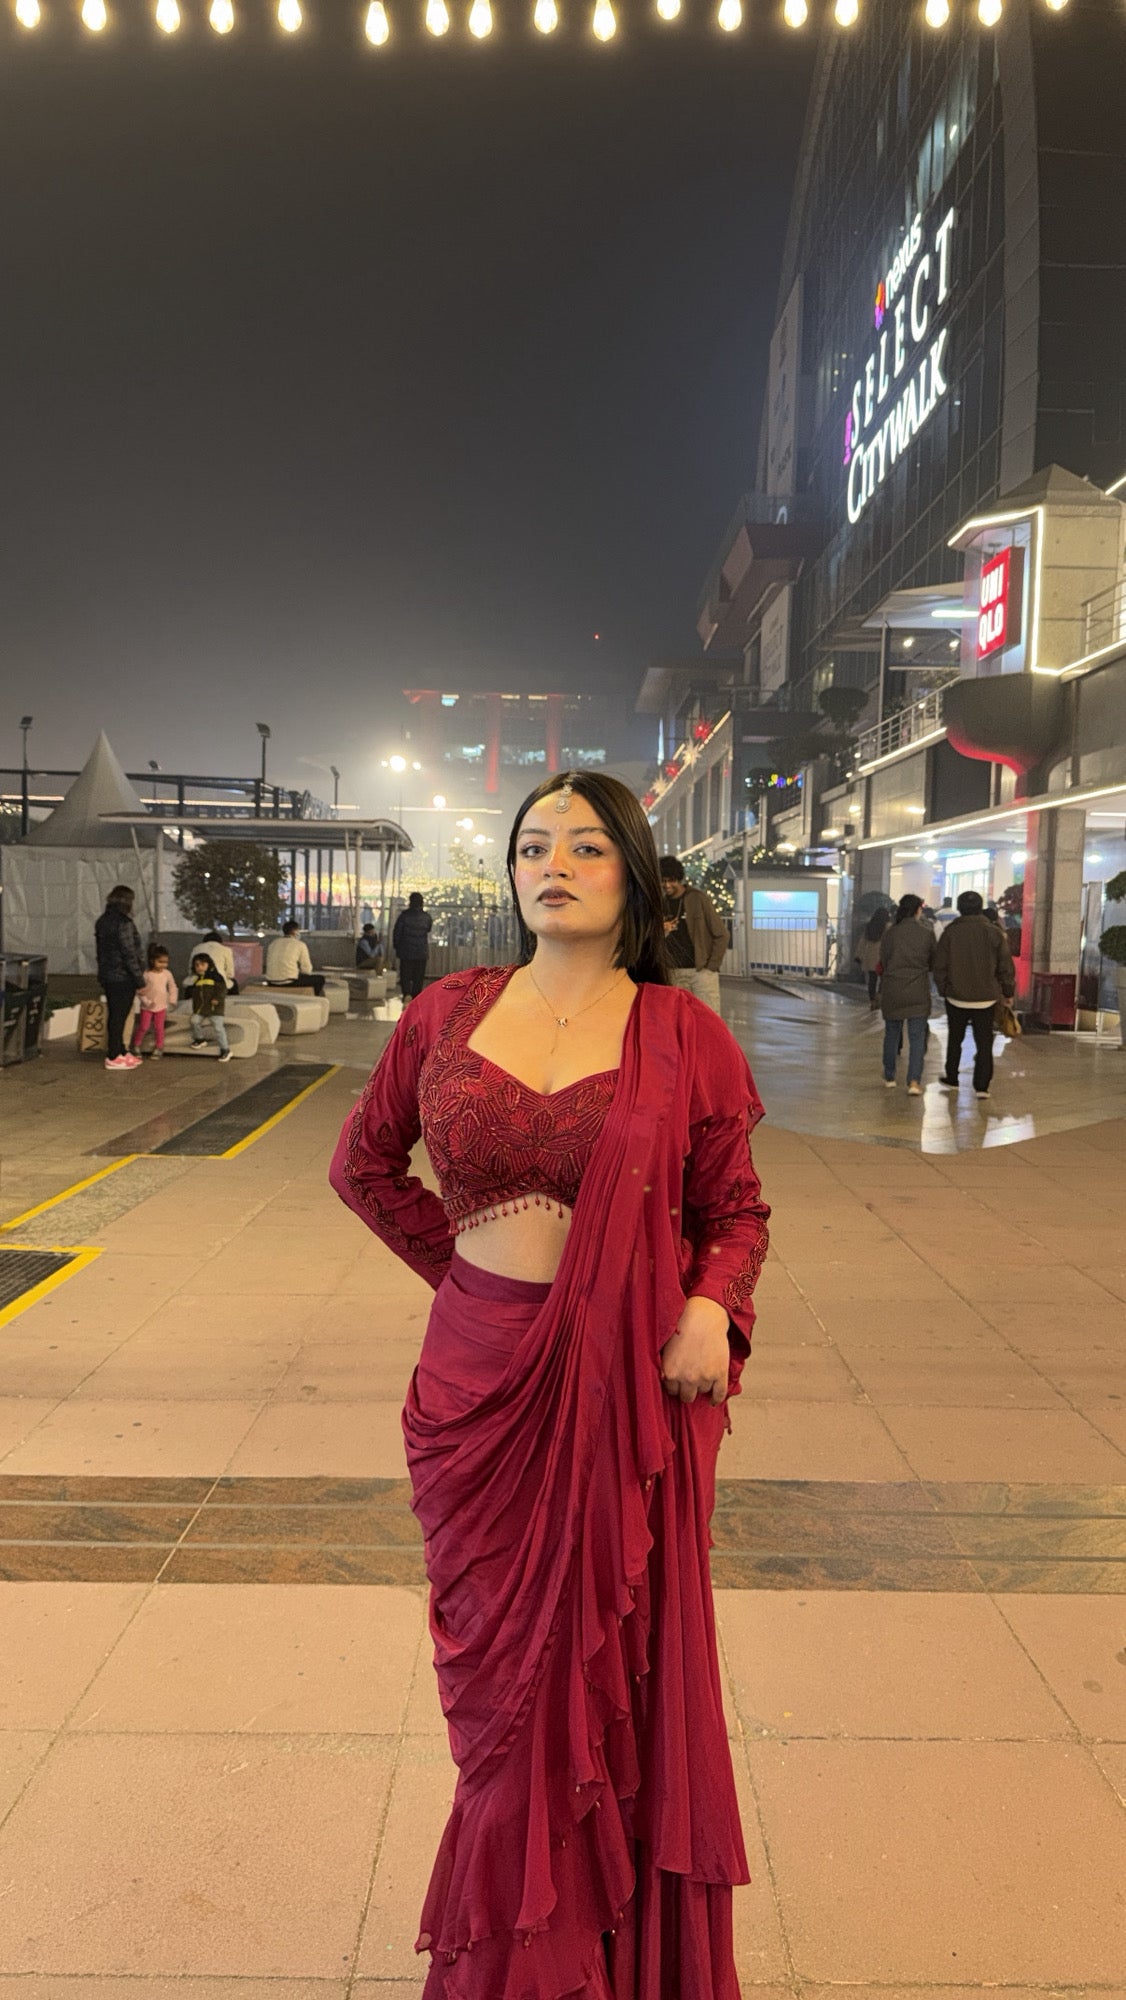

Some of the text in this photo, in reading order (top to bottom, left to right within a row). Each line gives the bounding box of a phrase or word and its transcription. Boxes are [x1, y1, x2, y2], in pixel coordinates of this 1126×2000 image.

[886, 212, 922, 309] nexus
[849, 207, 954, 449] SELECT
[847, 328, 947, 523] CITYWALK
[981, 563, 1005, 608] UNI
[978, 603, 1004, 651] QLO
[85, 1003, 104, 1051] M&S
